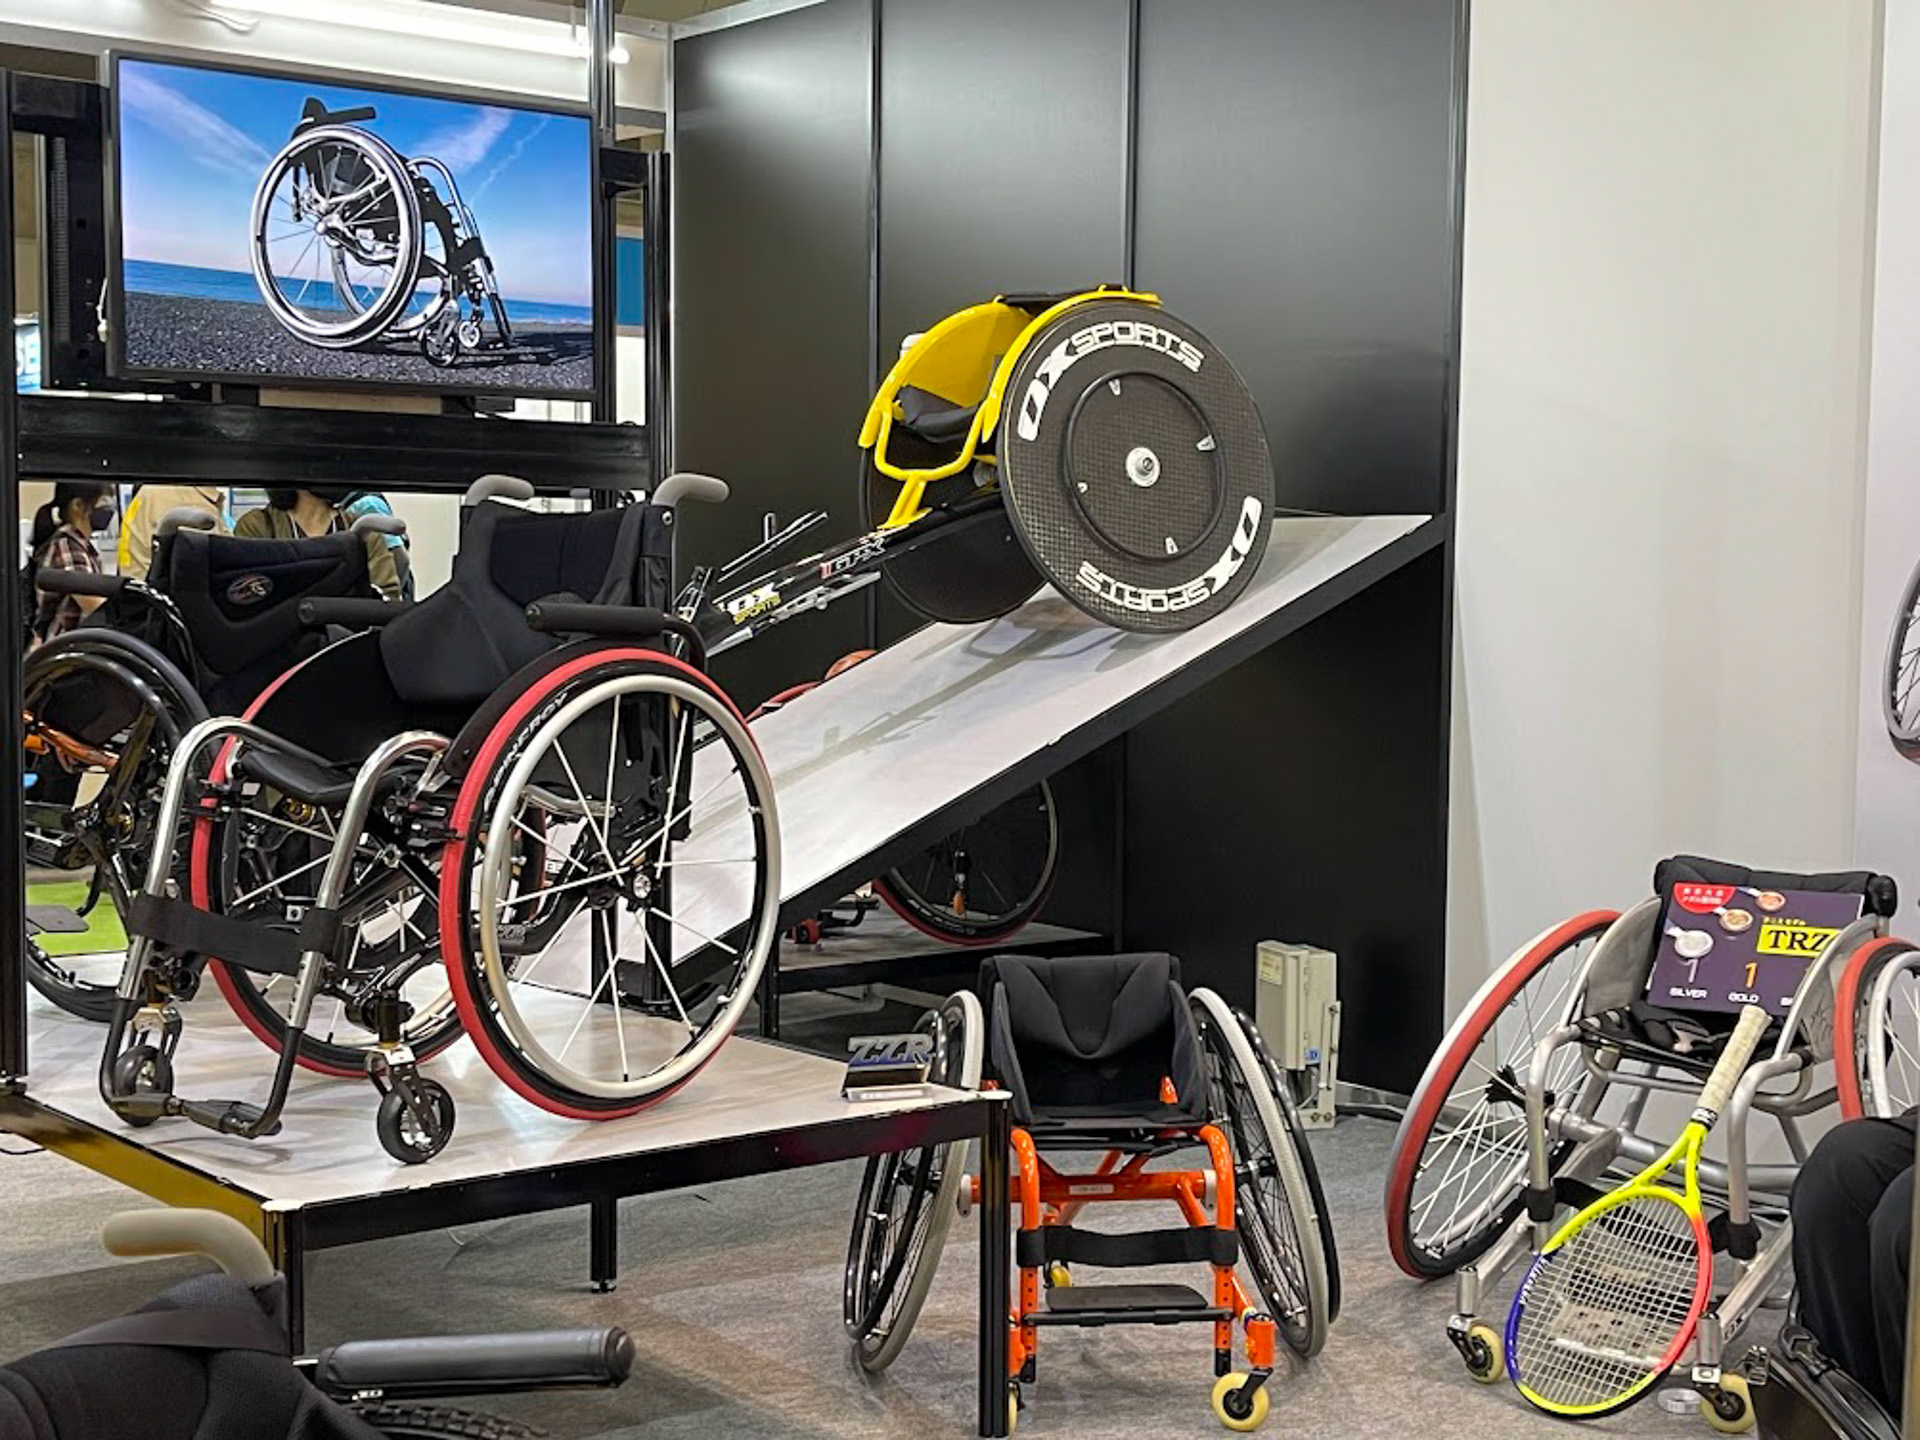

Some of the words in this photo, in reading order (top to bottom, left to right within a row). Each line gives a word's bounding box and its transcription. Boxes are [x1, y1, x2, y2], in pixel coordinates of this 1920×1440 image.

[1072, 321, 1205, 372] SPORTS
[1075, 560, 1212, 612] SPORTS
[1745, 961, 1758, 989] 1
[1669, 988, 1708, 998] SILVER
[1728, 992, 1760, 1004] GOLD
